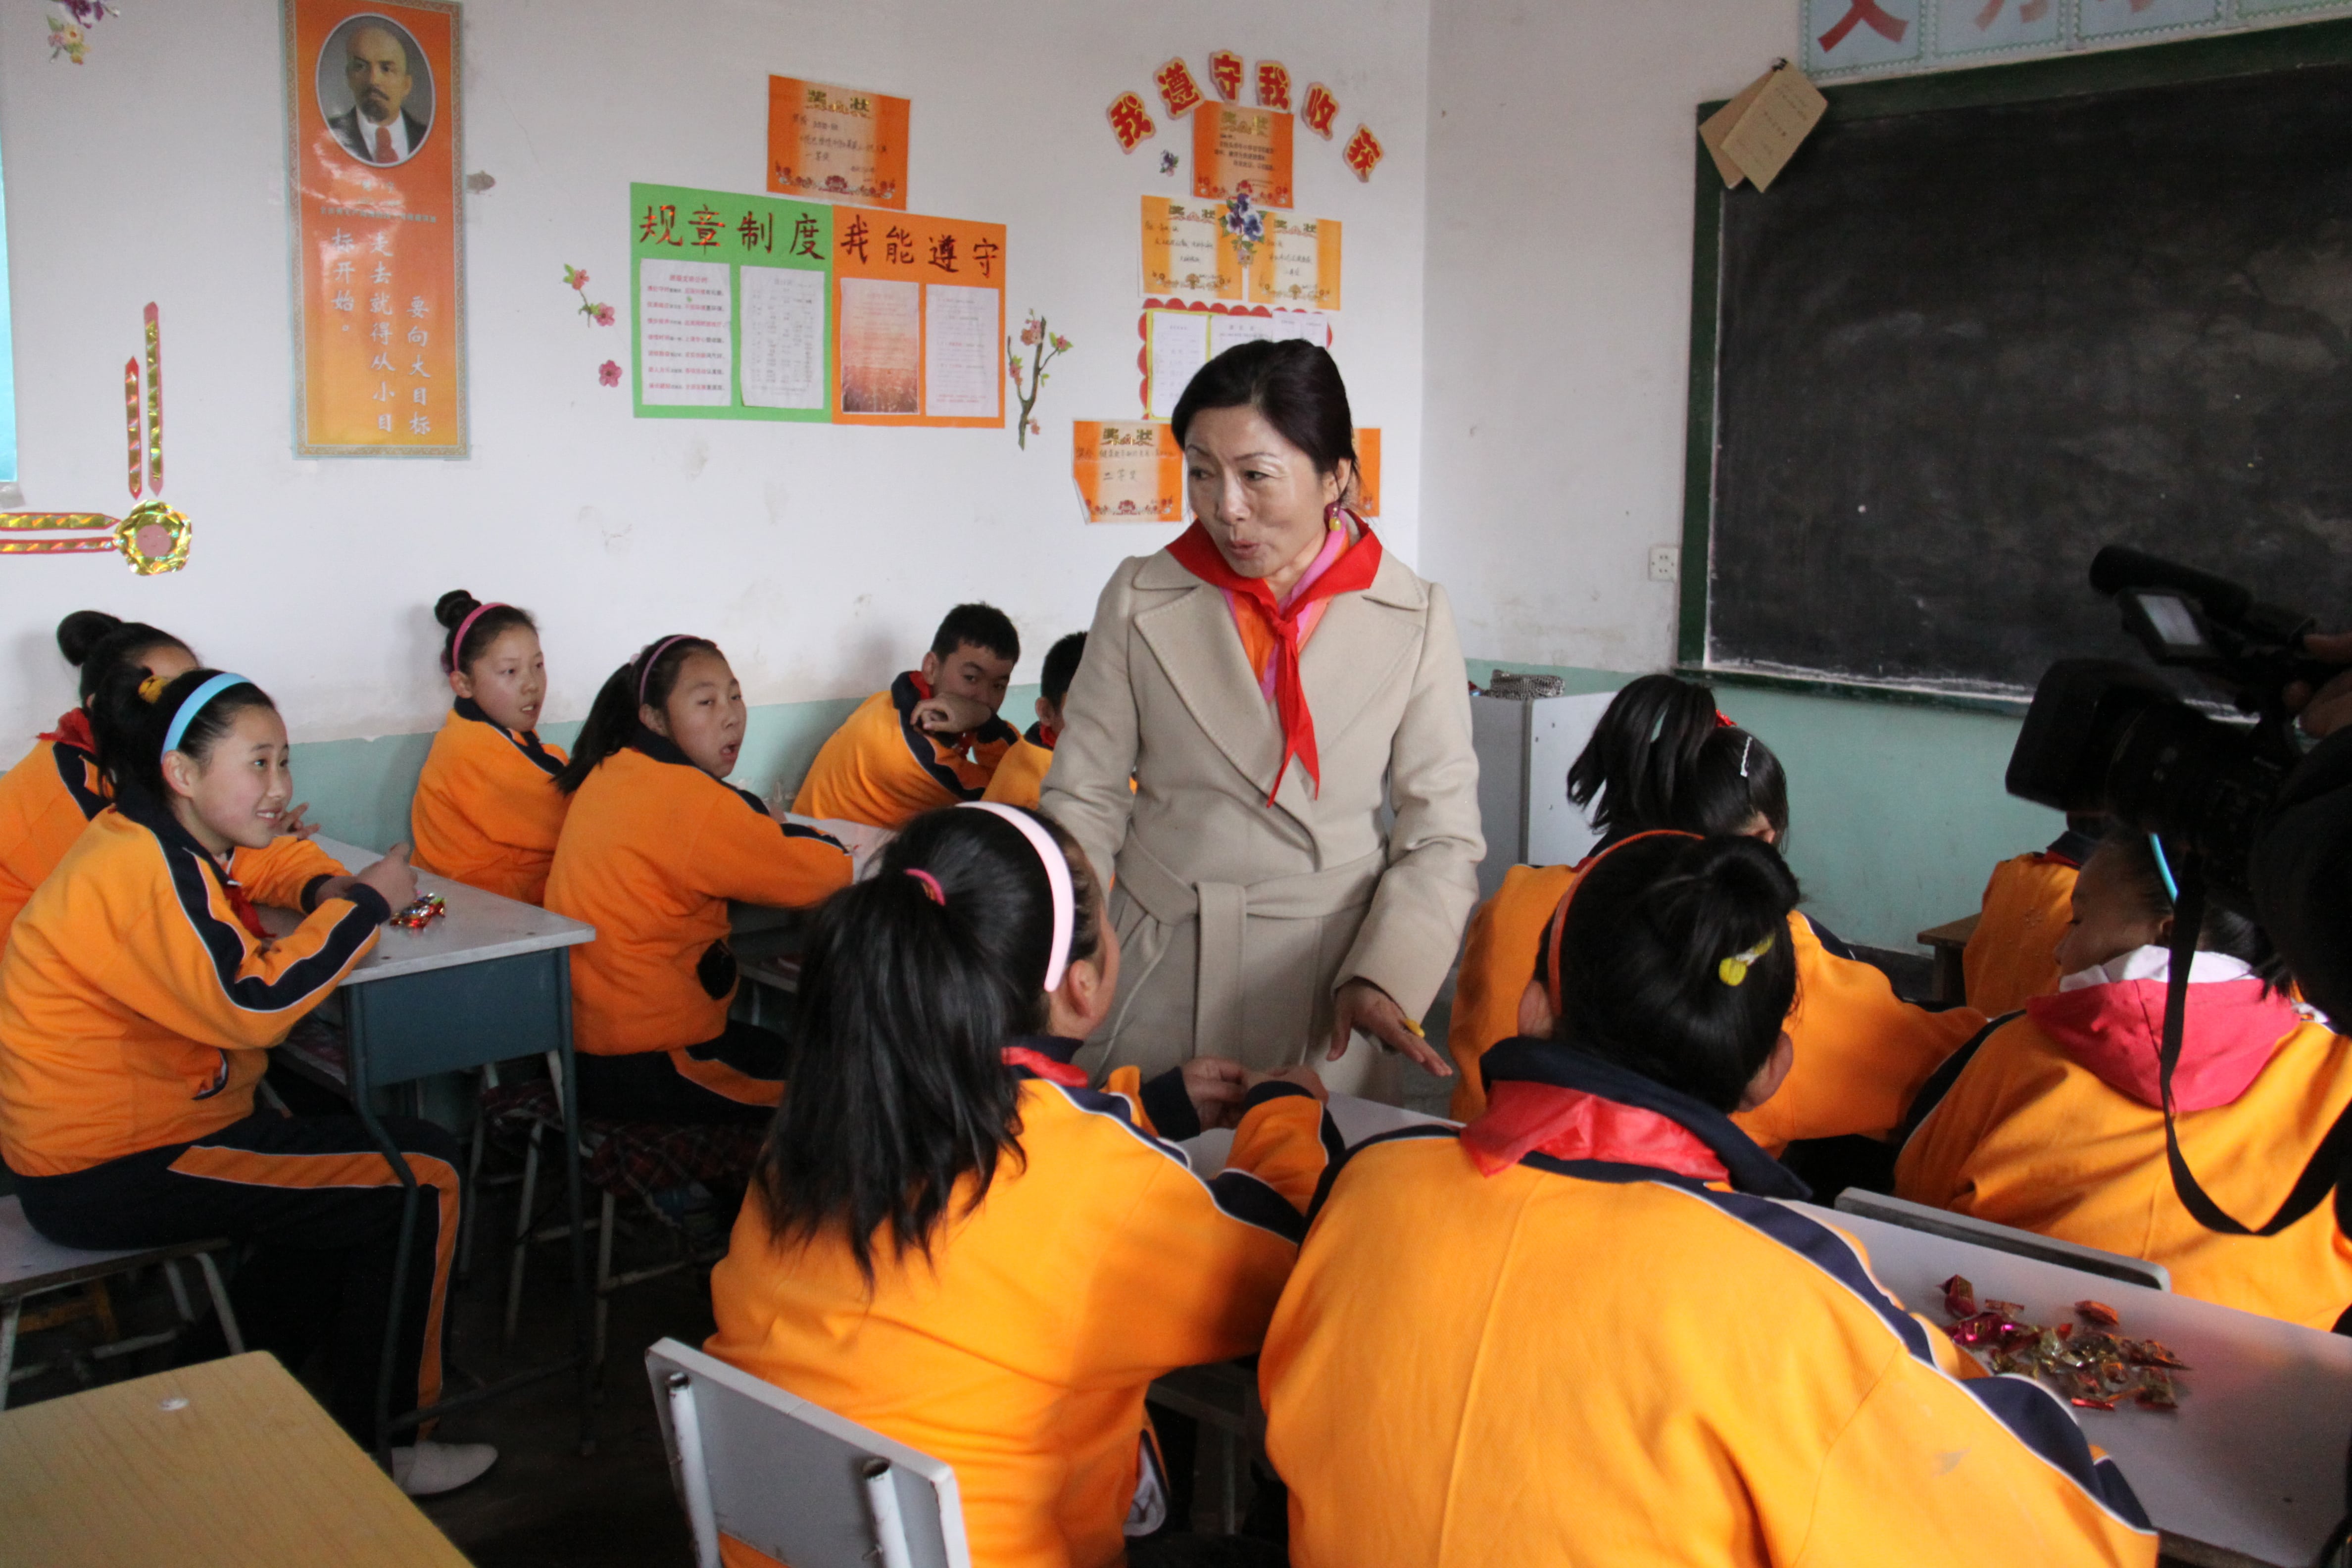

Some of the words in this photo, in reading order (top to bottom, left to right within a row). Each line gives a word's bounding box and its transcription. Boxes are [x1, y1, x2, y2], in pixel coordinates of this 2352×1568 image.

[638, 204, 826, 260] 规章制度
[840, 213, 1000, 278] 我能遵守
[369, 232, 396, 433] 走去就得从小目
[406, 295, 431, 435] 要向大目标
